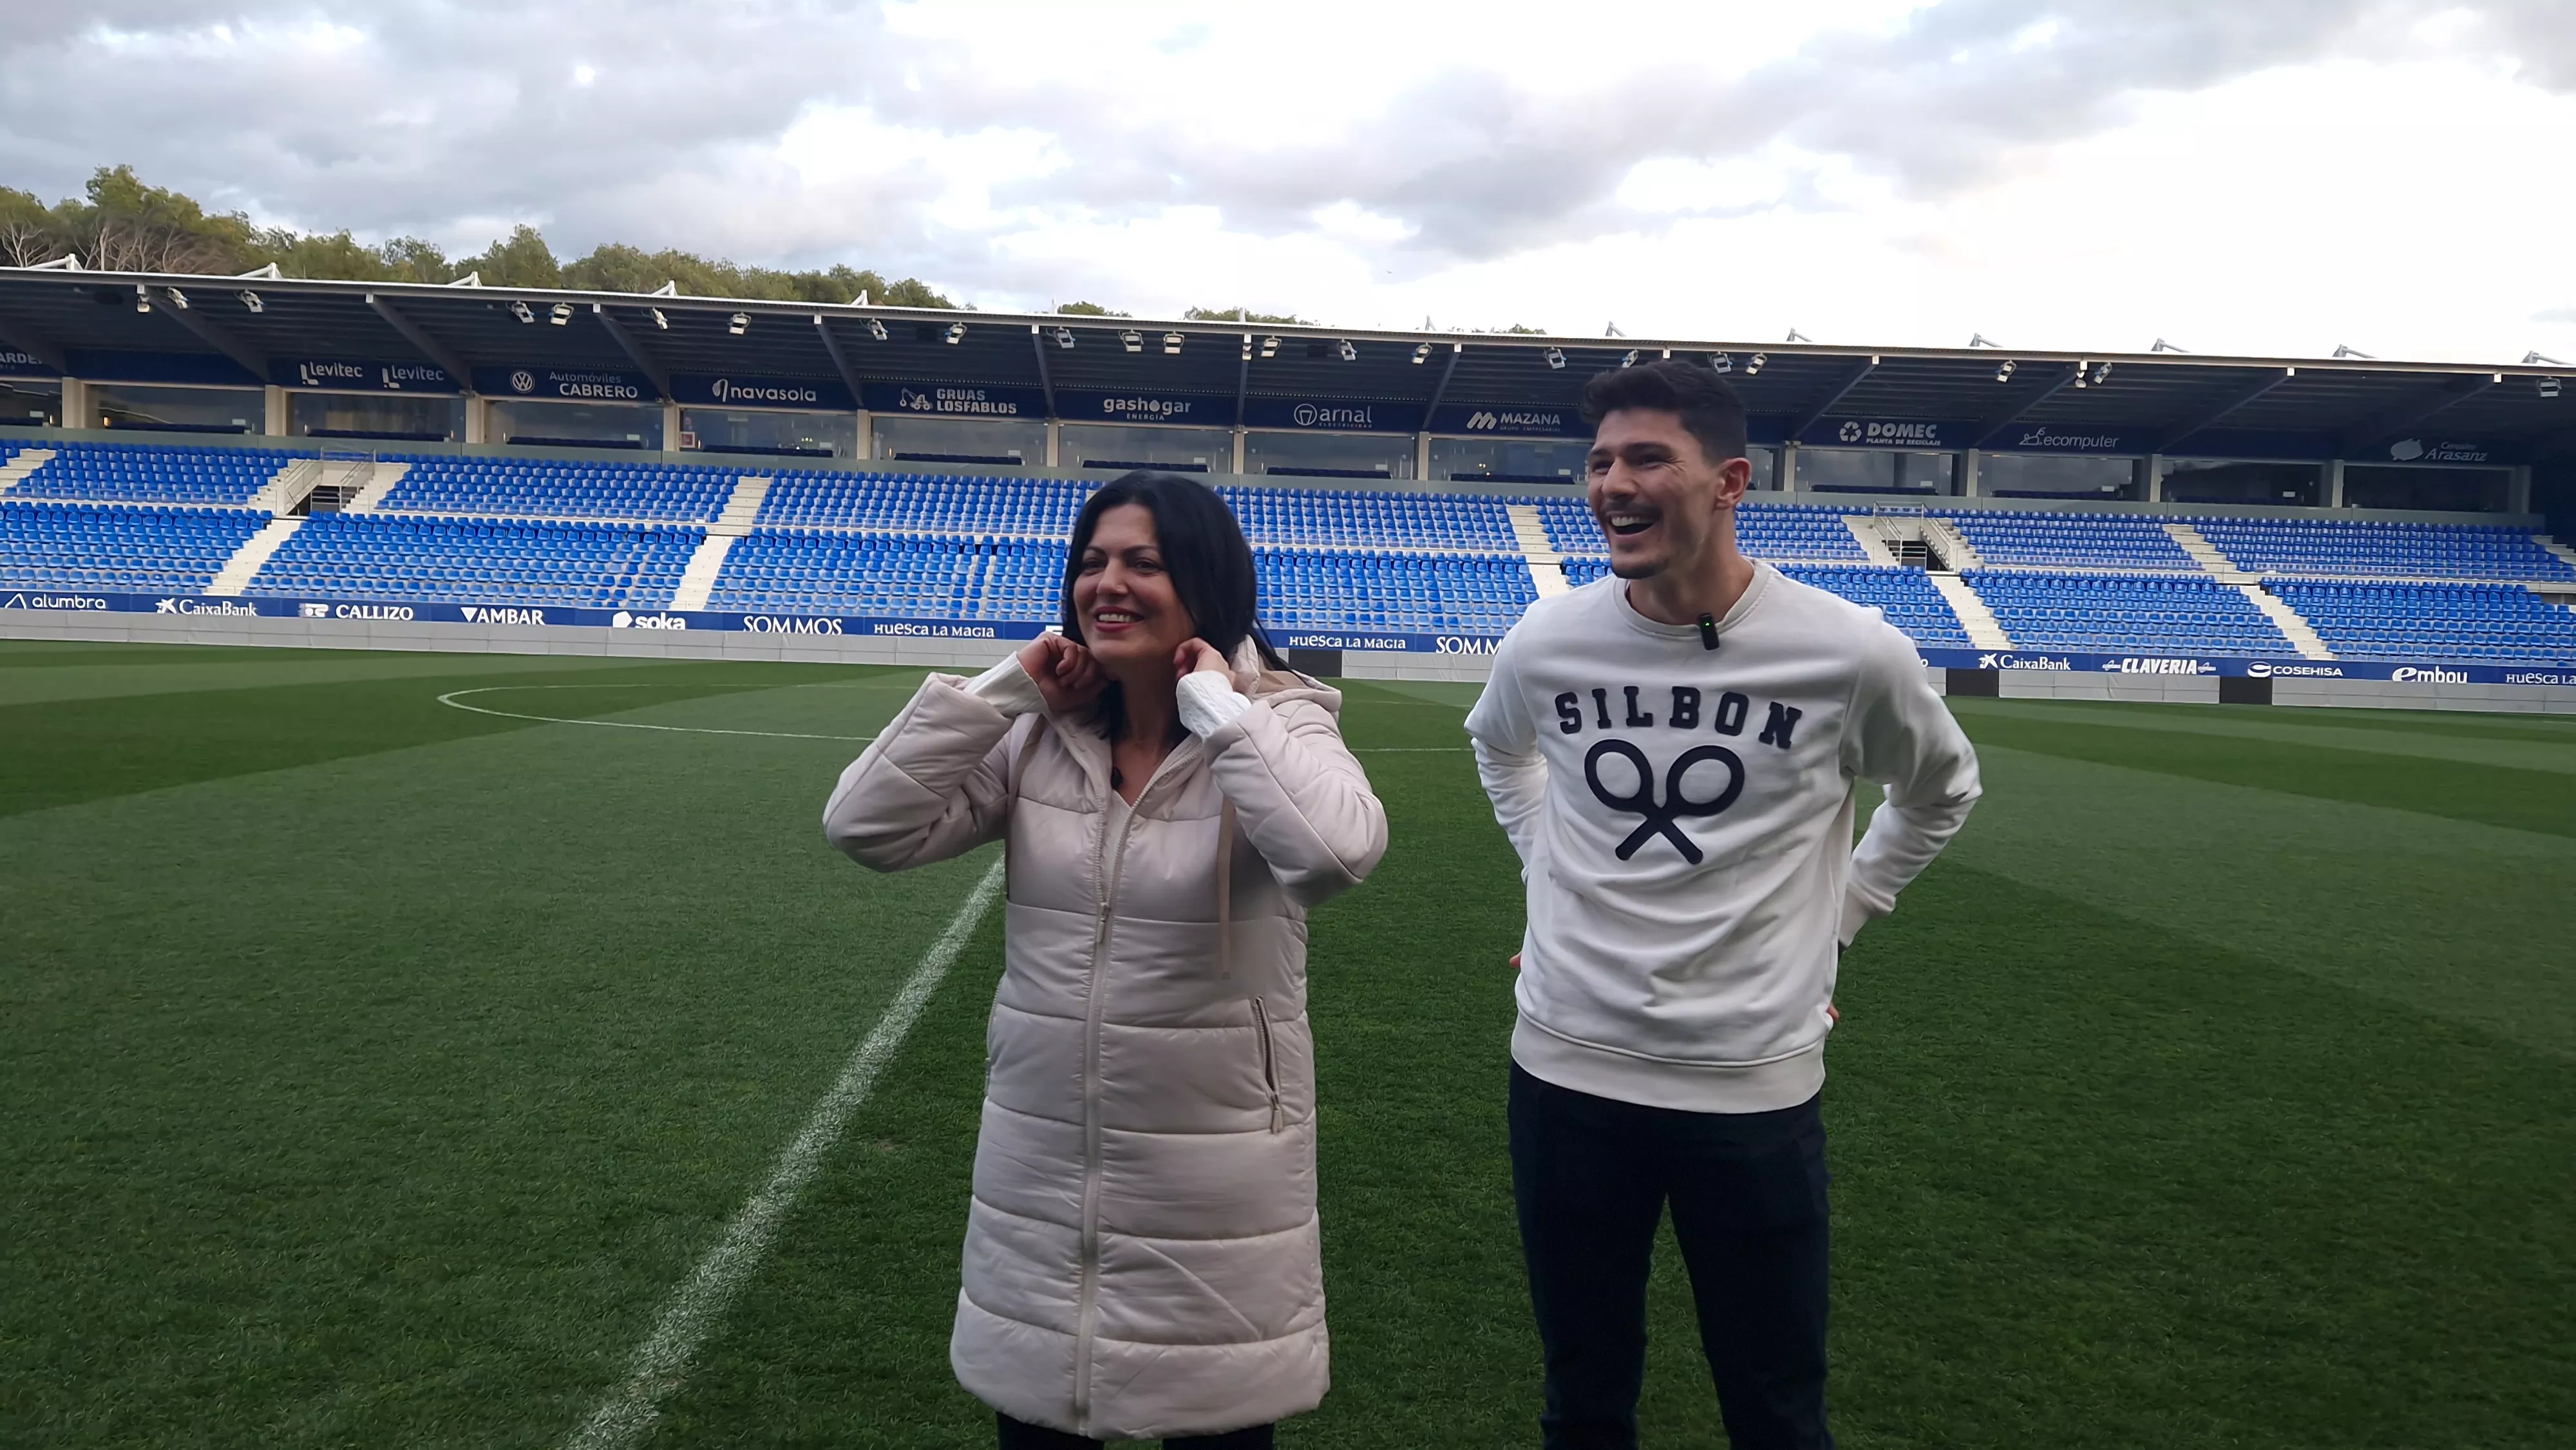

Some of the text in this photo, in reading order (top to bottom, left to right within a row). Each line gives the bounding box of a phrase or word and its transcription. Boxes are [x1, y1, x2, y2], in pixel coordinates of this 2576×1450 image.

[549, 371, 621, 384] Automóviles
[559, 383, 638, 399] CABRERO
[730, 386, 817, 402] navasola
[936, 388, 986, 401] GRUAS
[936, 400, 1018, 414] LOSFABLOS
[1319, 405, 1372, 424] arnal
[1500, 413, 1561, 426] MAZANA
[1867, 422, 1938, 439] DOMEC
[2043, 435, 2119, 450] ecomputer
[2424, 447, 2488, 462] Arasanz
[32, 594, 106, 609] alumbra
[179, 599, 258, 616] CaixaBank
[336, 604, 413, 621] CALLIZO
[477, 607, 545, 625] AMBAR
[635, 612, 686, 630] soka
[743, 616, 843, 636] SOMMOS
[1435, 636, 1502, 655] SOMM
[2000, 655, 2071, 670] CaixaBank
[2121, 658, 2197, 675] CLAVERIA
[2273, 666, 2344, 677] COSEHISA
[2392, 665, 2468, 684] embou
[1554, 686, 1802, 749] SILBON
